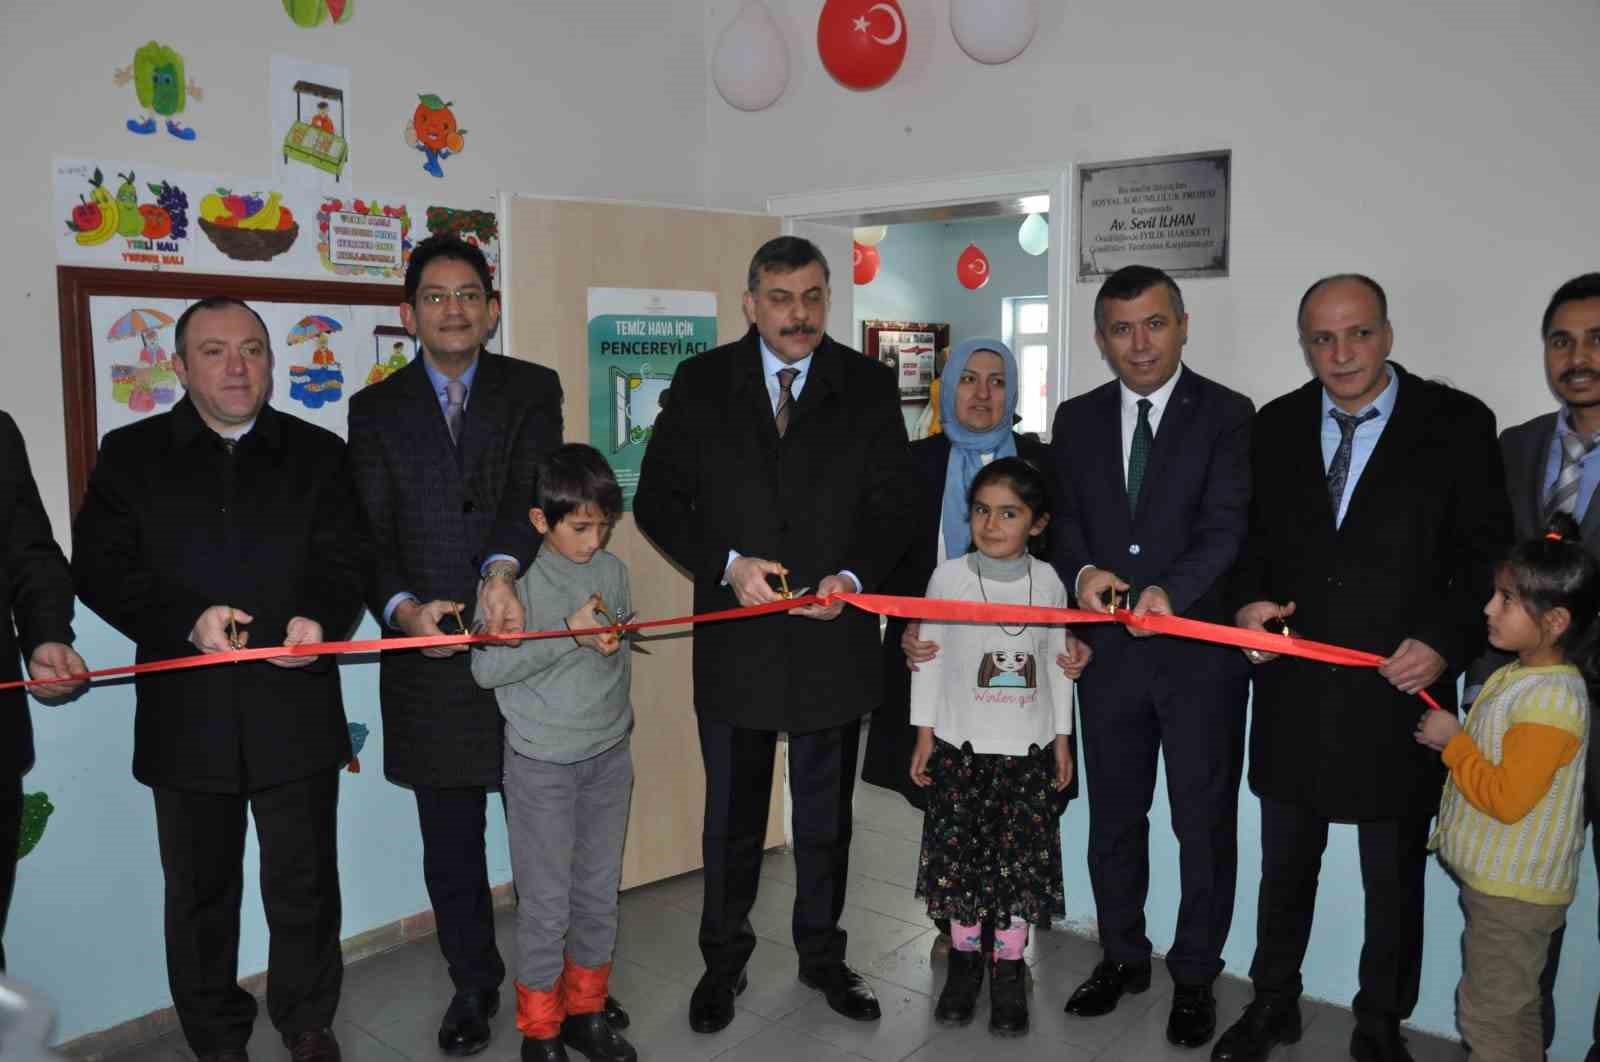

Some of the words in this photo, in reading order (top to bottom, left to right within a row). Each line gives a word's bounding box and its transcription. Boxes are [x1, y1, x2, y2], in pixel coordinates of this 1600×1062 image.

[1110, 218, 1127, 231] Av.
[1130, 216, 1157, 230] Sevil
[615, 319, 646, 337] TEMİZ
[648, 320, 673, 337] HAVA
[675, 319, 694, 338] İÇİN
[600, 339, 682, 355] PENCEREYİ
